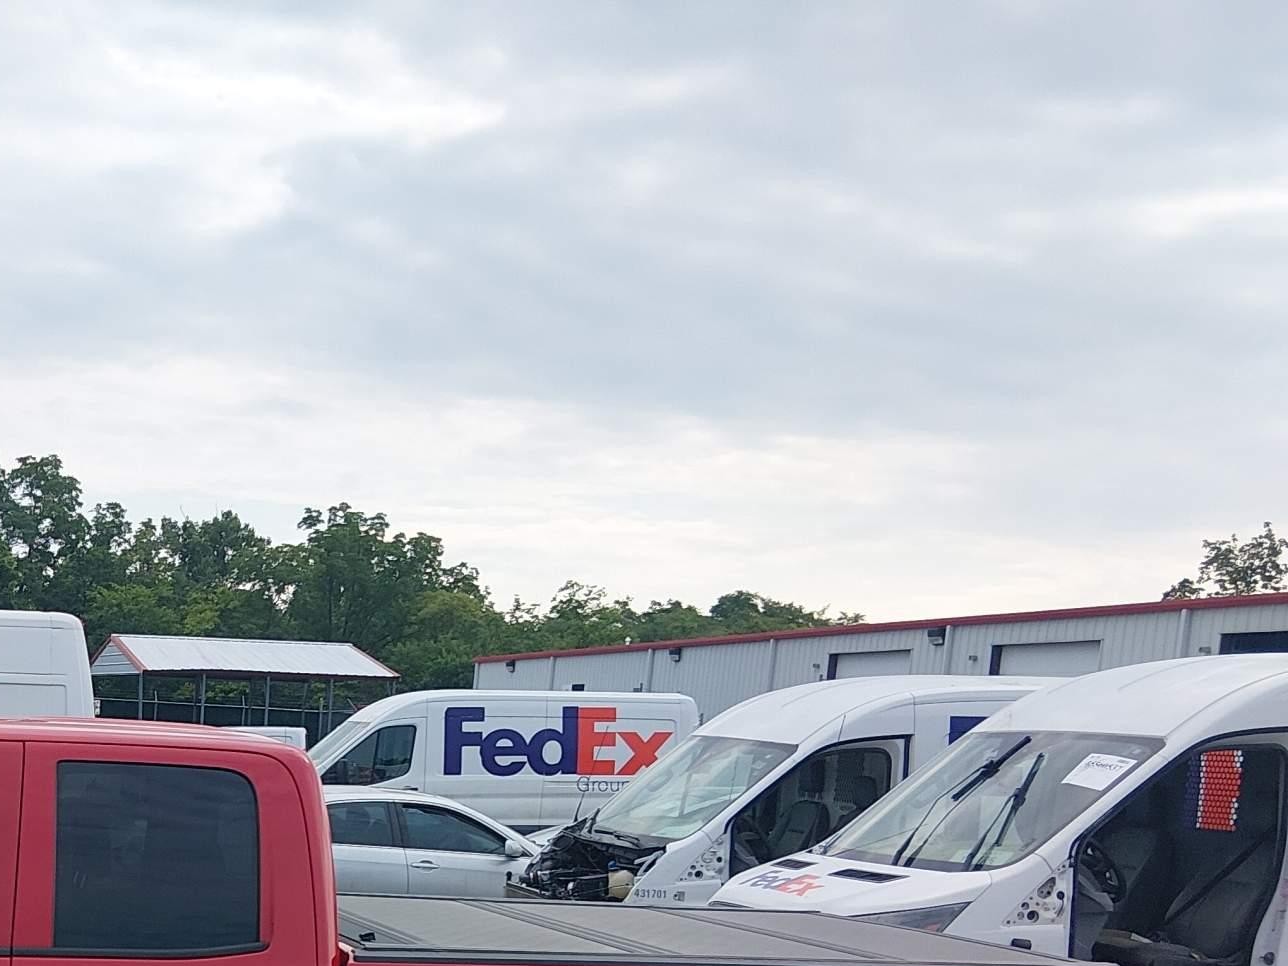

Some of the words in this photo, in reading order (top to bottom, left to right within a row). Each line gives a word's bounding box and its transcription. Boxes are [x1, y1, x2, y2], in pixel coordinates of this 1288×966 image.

[443, 706, 673, 776] FedEx
[634, 889, 667, 899] 431701
[738, 870, 825, 897] FedEx
